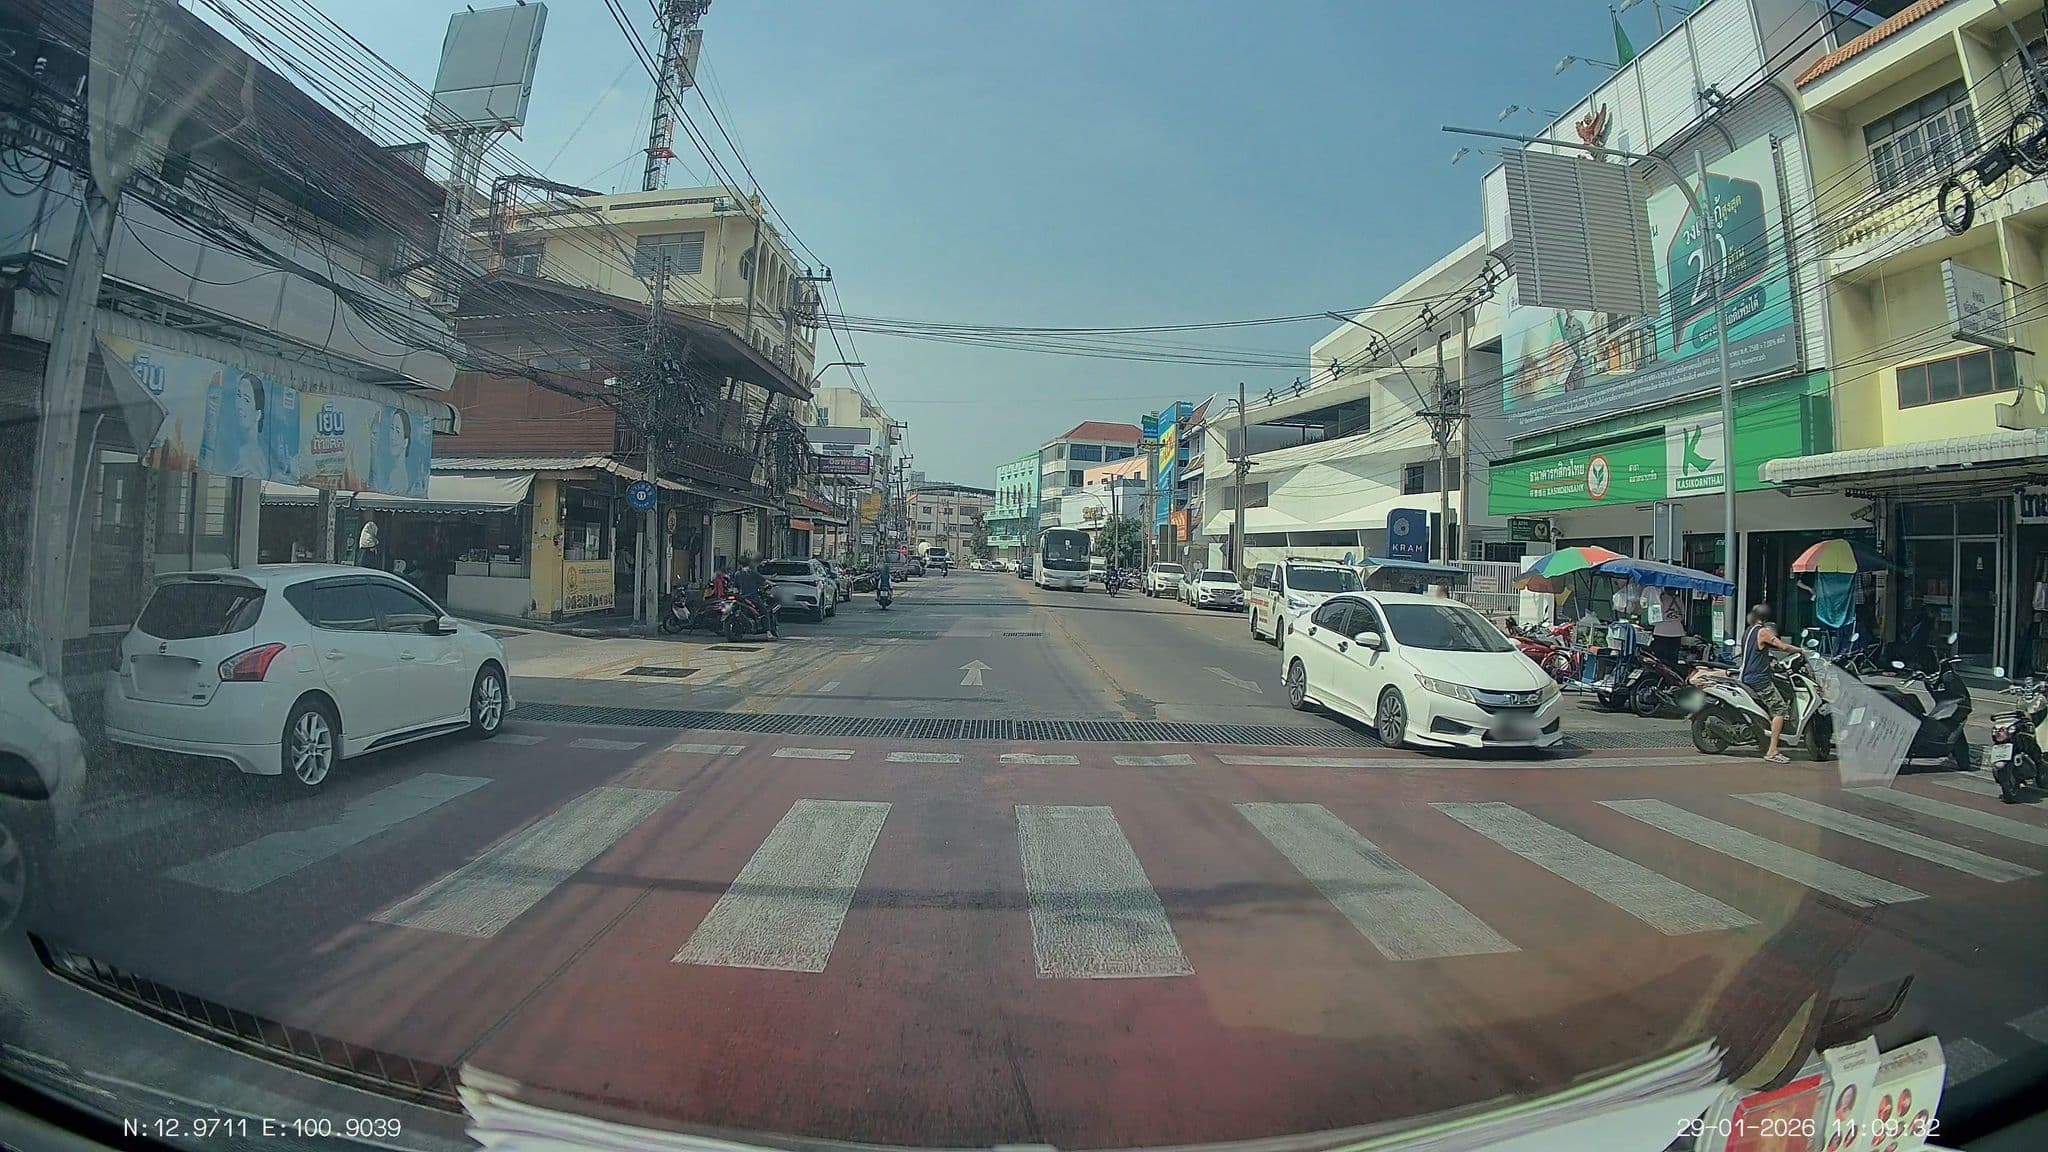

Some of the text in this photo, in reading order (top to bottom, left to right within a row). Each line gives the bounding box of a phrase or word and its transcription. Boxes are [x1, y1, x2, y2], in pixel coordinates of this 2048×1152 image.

[1529, 458, 1585, 483] ธนาคารกสิกรไทย
[1676, 474, 1723, 490] KASIKORNTHAI
[1547, 484, 1585, 496] KASIKORNBANK
[1392, 543, 1424, 553] KRAM
